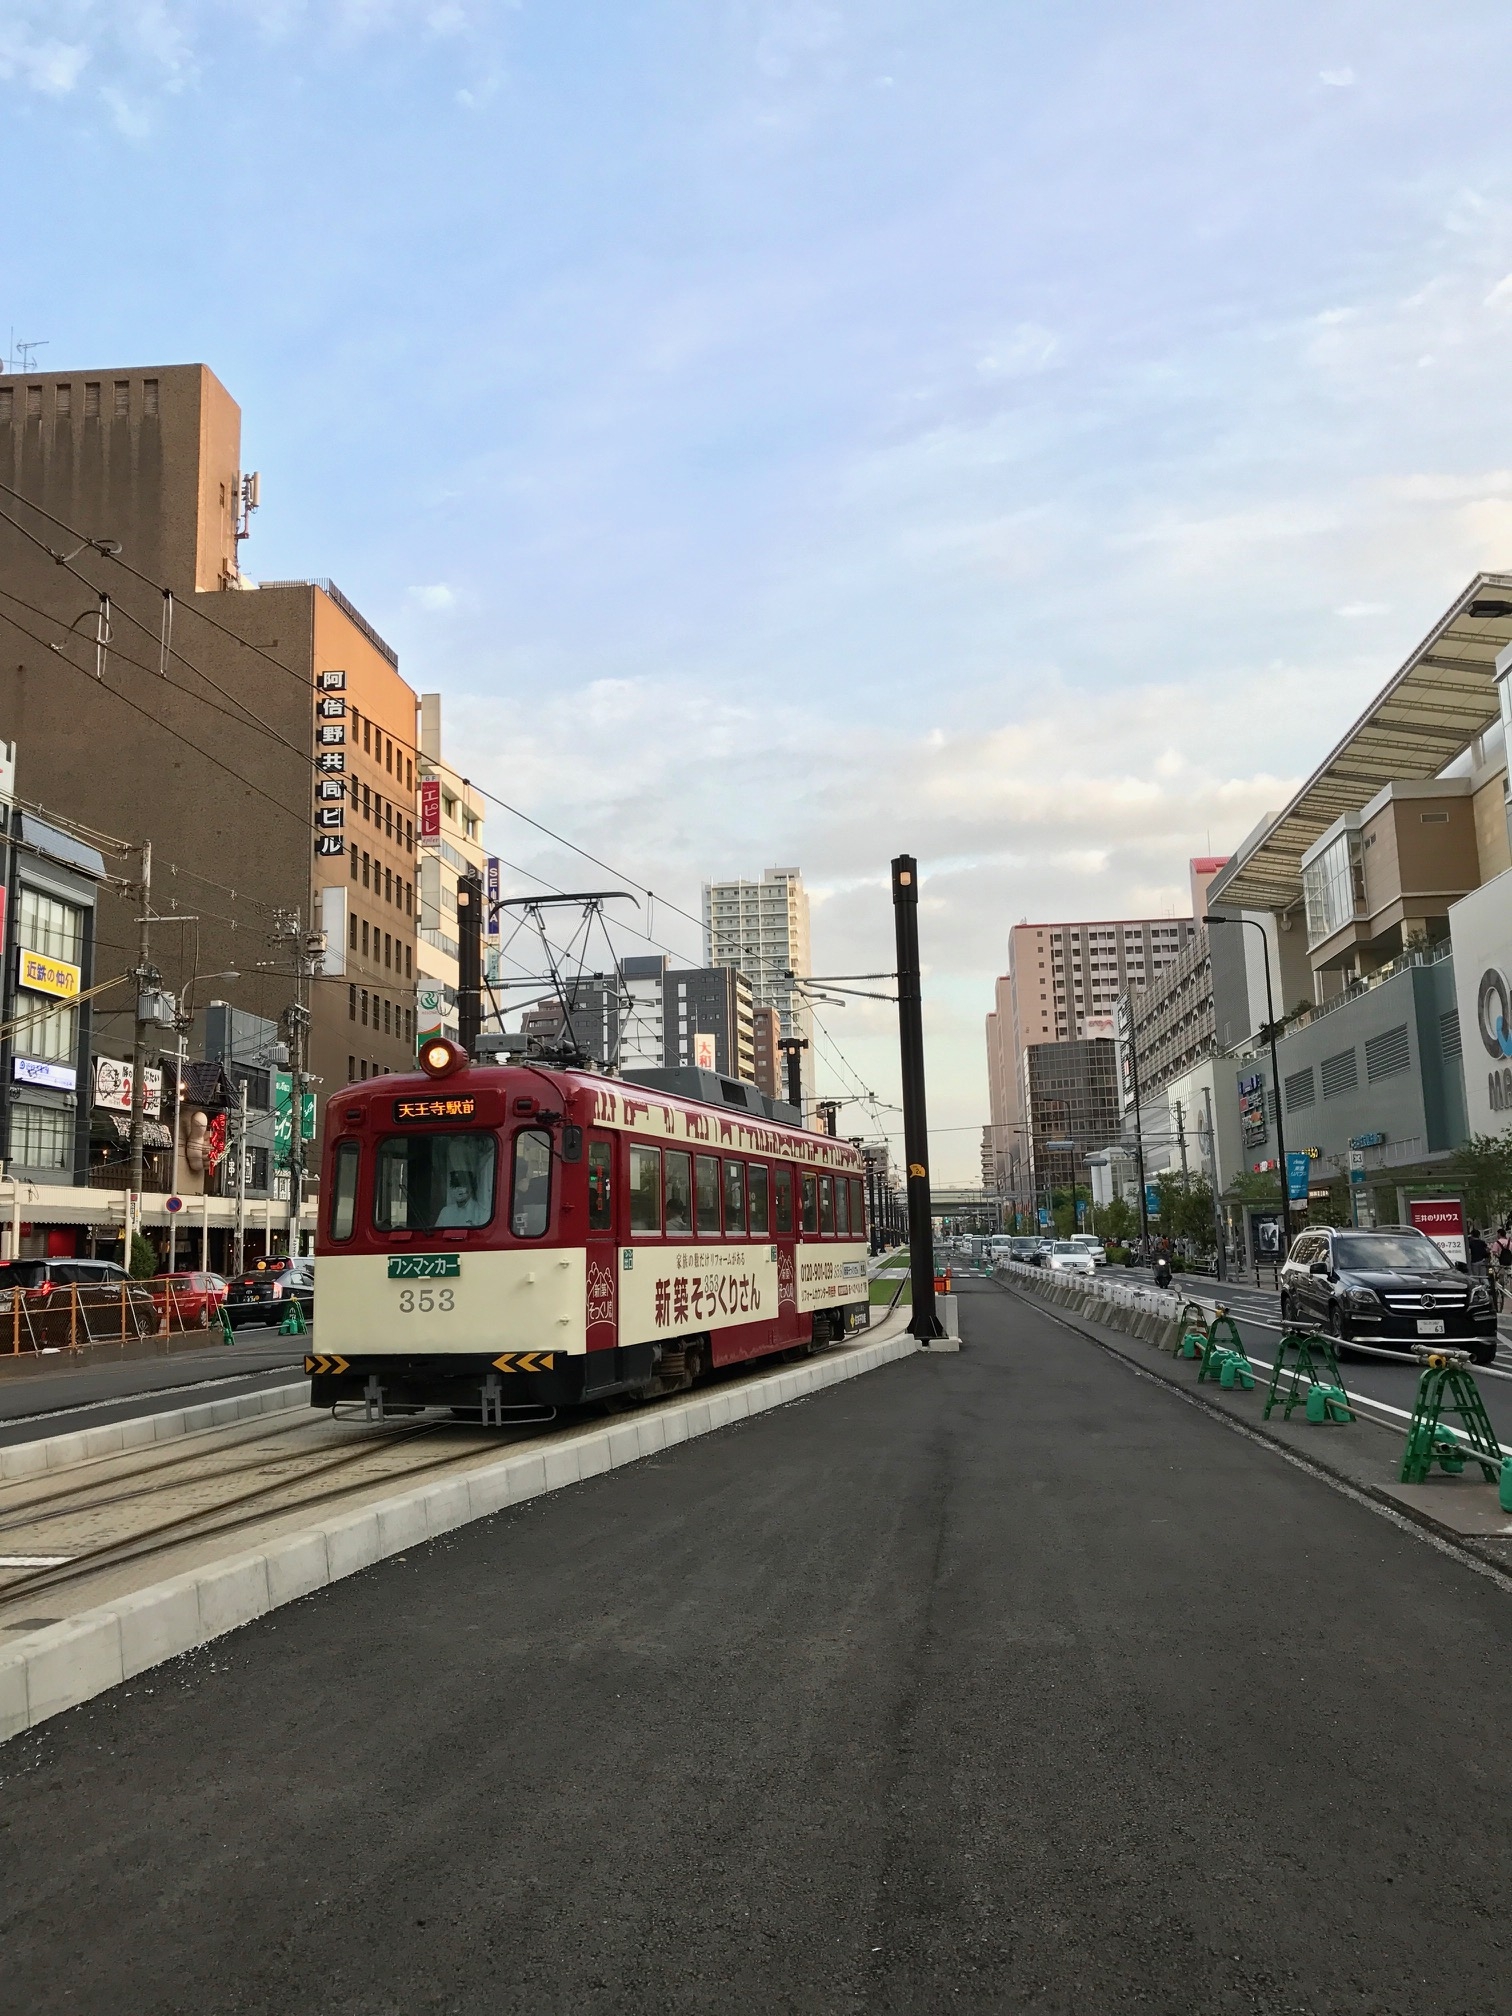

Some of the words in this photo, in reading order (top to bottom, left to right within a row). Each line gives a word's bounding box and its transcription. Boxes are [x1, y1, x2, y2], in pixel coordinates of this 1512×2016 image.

[322, 671, 344, 854] 阿倍野共同ビル
[27, 961, 74, 991] 近鉄の仲介
[398, 1099, 474, 1117] 天王寺駅前
[1414, 1213, 1459, 1223] 三井のリハウス
[390, 1258, 457, 1275] ワンマンカー
[704, 1274, 719, 1293] 353
[399, 1289, 455, 1313] 353
[655, 1273, 760, 1328] 新築そっくりさん
